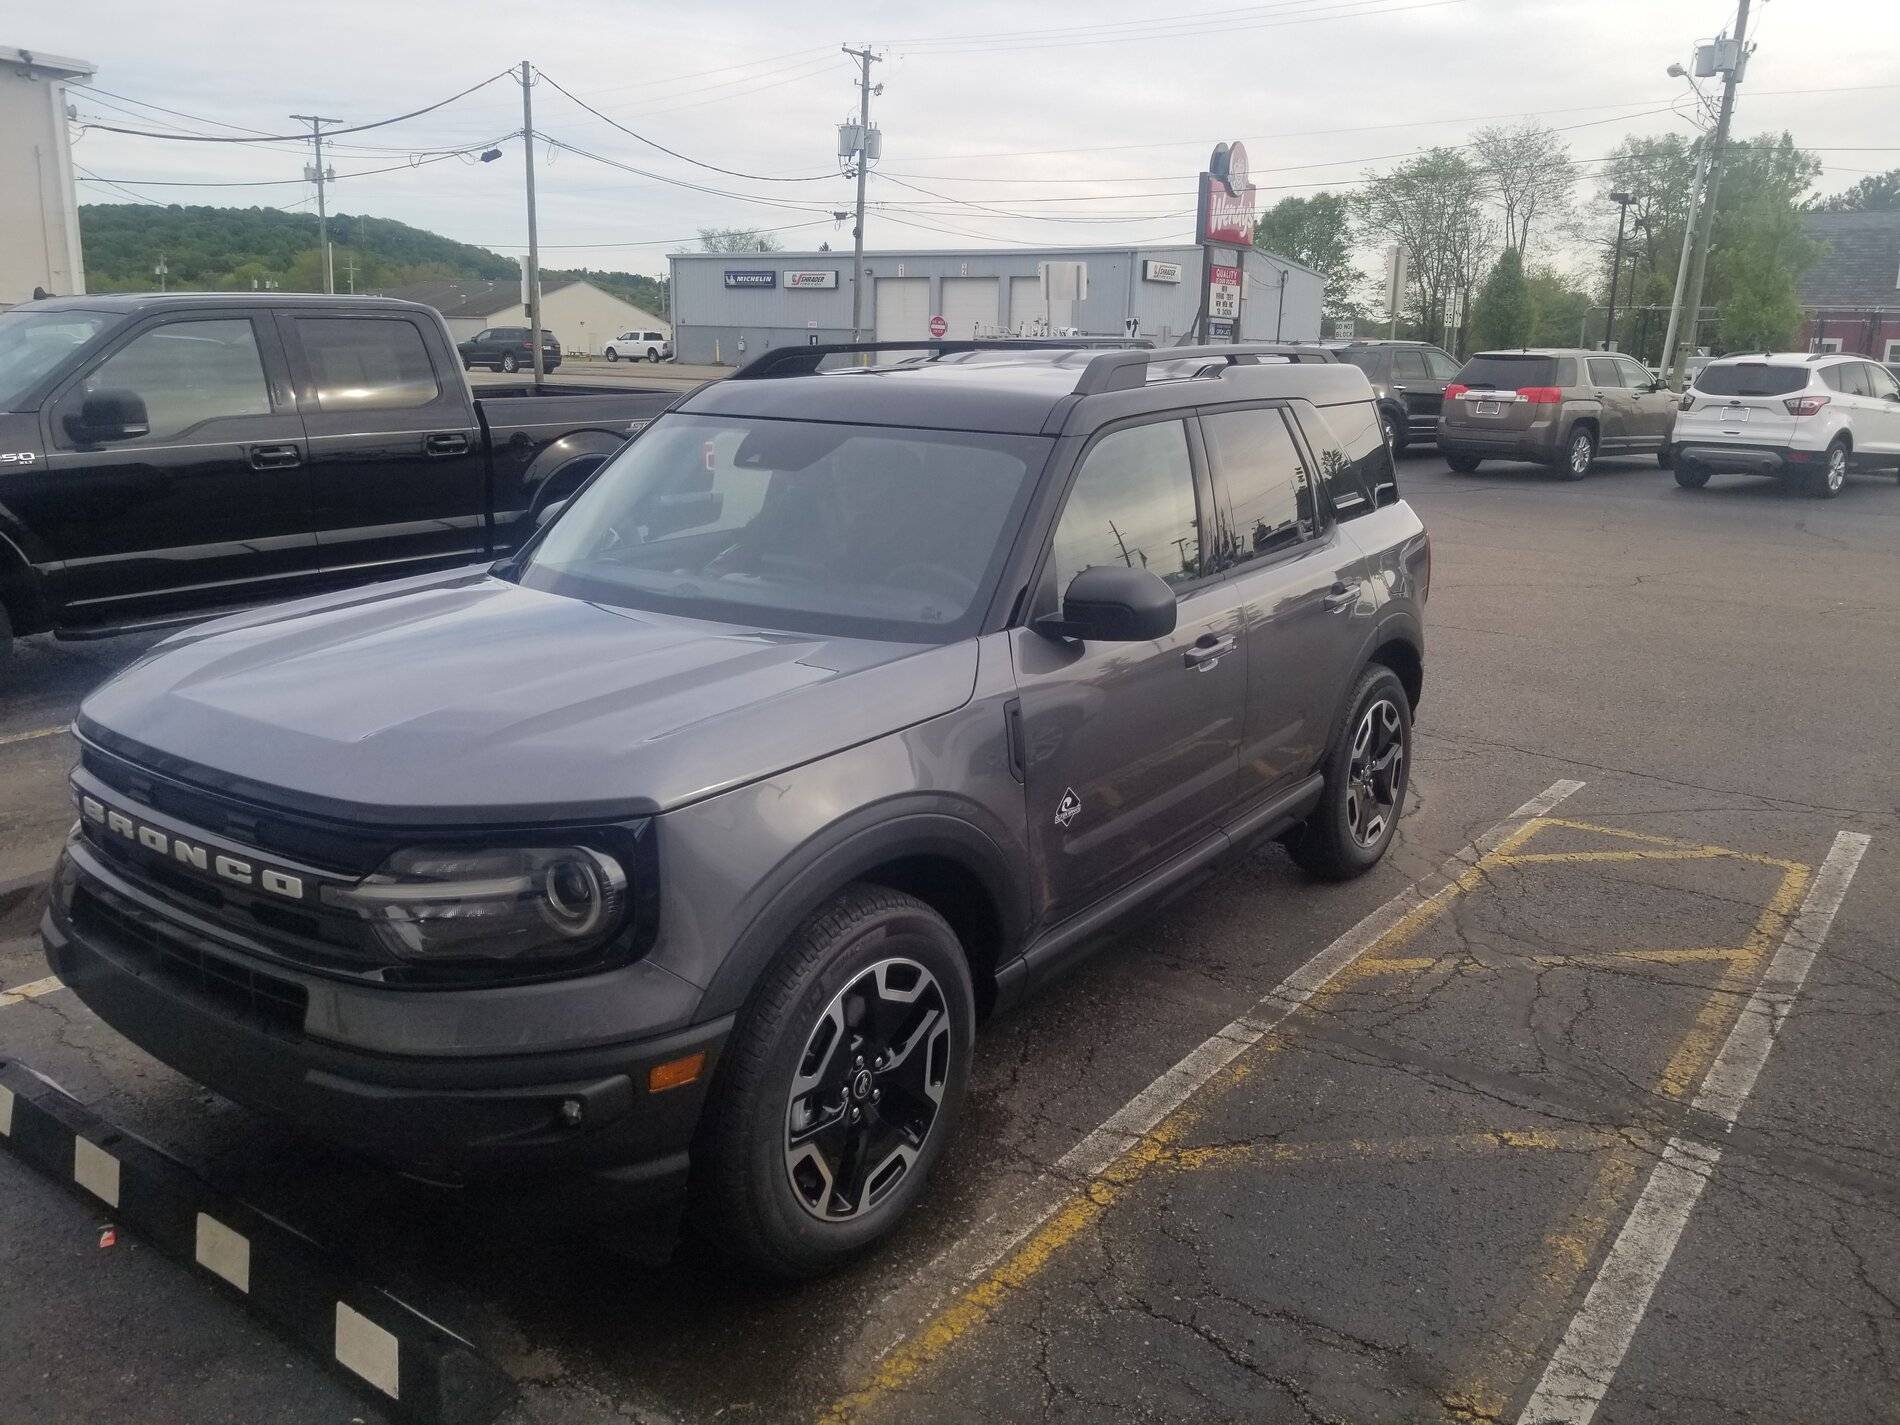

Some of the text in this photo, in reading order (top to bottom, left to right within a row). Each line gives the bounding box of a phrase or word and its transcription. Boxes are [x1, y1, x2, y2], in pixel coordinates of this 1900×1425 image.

[1210, 192, 1255, 238] Wendy's
[0, 452, 35, 462] 50
[84, 795, 303, 900] BRONCO
